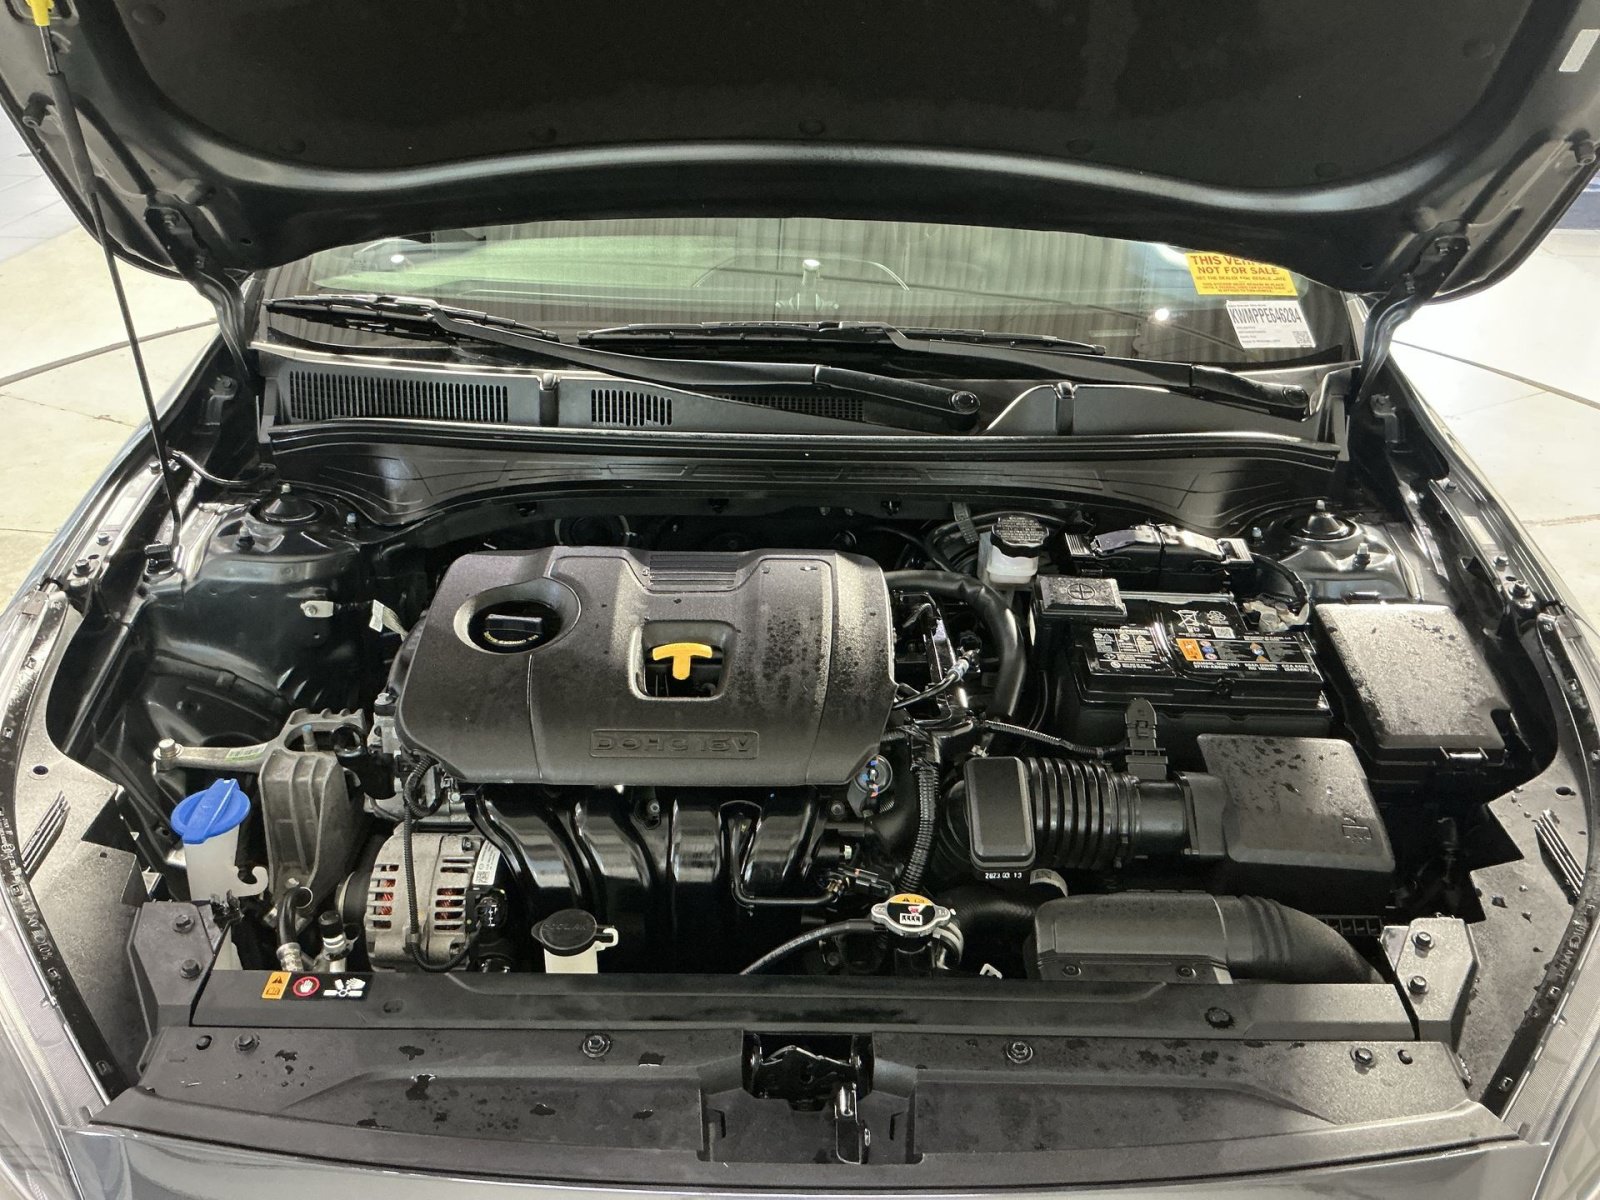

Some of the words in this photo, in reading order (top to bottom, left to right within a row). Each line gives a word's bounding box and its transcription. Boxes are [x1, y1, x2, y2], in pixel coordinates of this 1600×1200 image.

[1190, 255, 1221, 266] THIS
[1197, 266, 1221, 274] NOT
[1225, 267, 1247, 275] FOR
[1229, 308, 1302, 325] KWMPPE646284
[593, 735, 688, 751] DOHC
[700, 736, 750, 751] 16V
